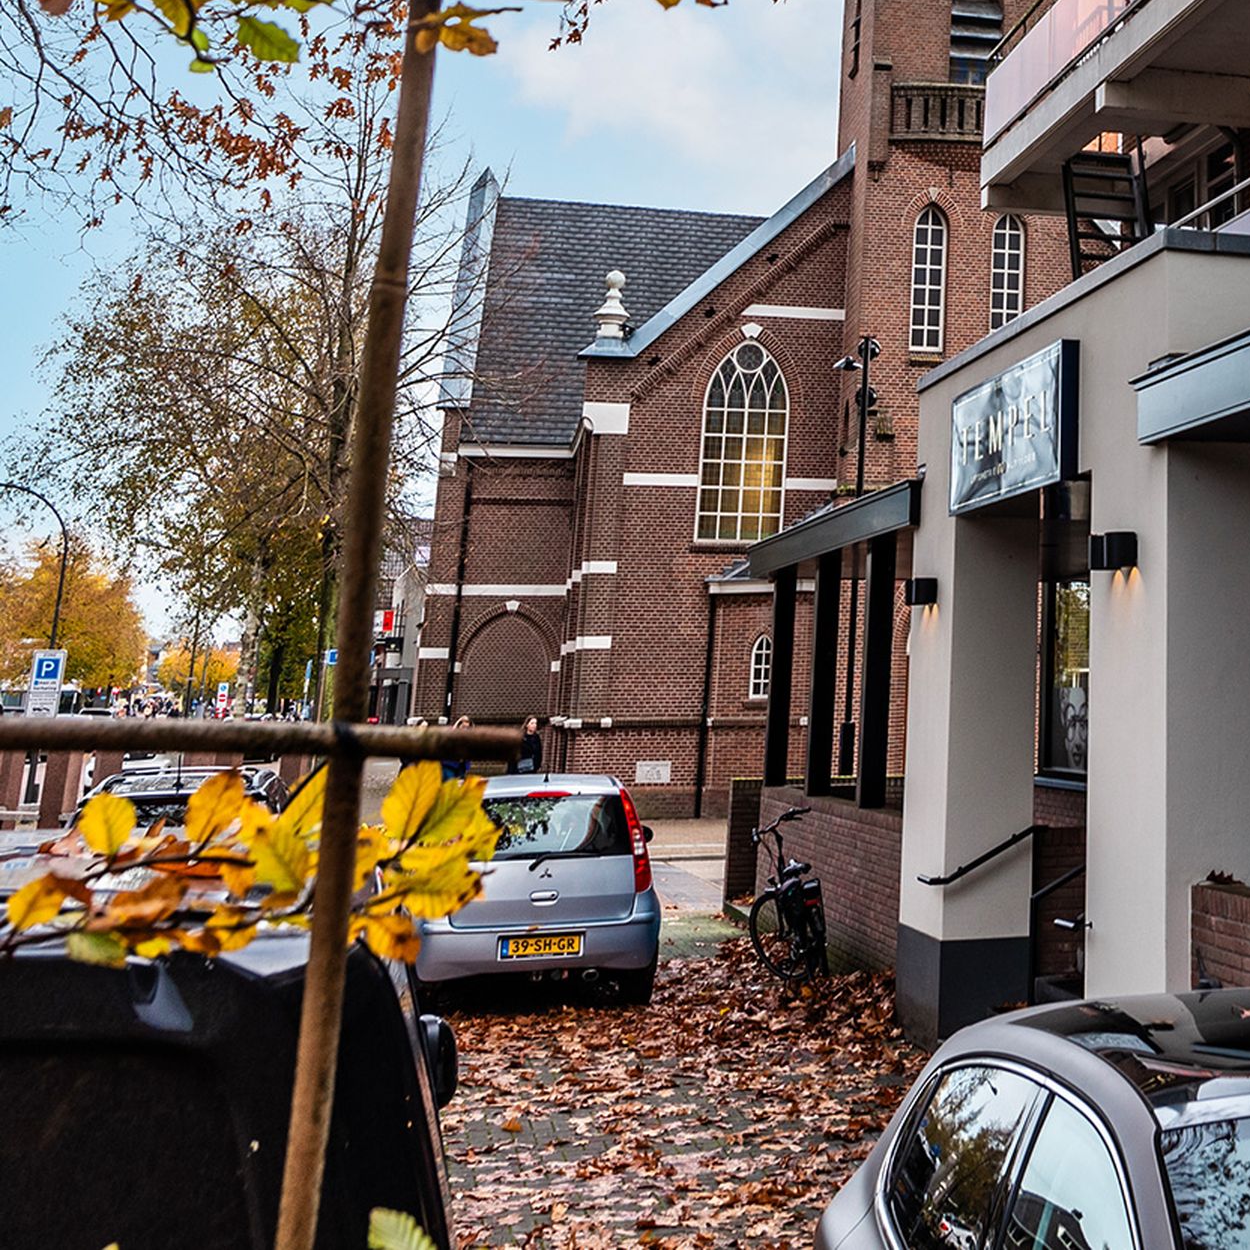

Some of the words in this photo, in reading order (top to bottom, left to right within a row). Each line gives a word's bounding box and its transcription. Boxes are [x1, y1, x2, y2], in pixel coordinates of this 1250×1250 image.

[961, 390, 1052, 466] TEMPEL
[41, 660, 55, 677] P
[511, 937, 575, 953] 39-SH-GR
